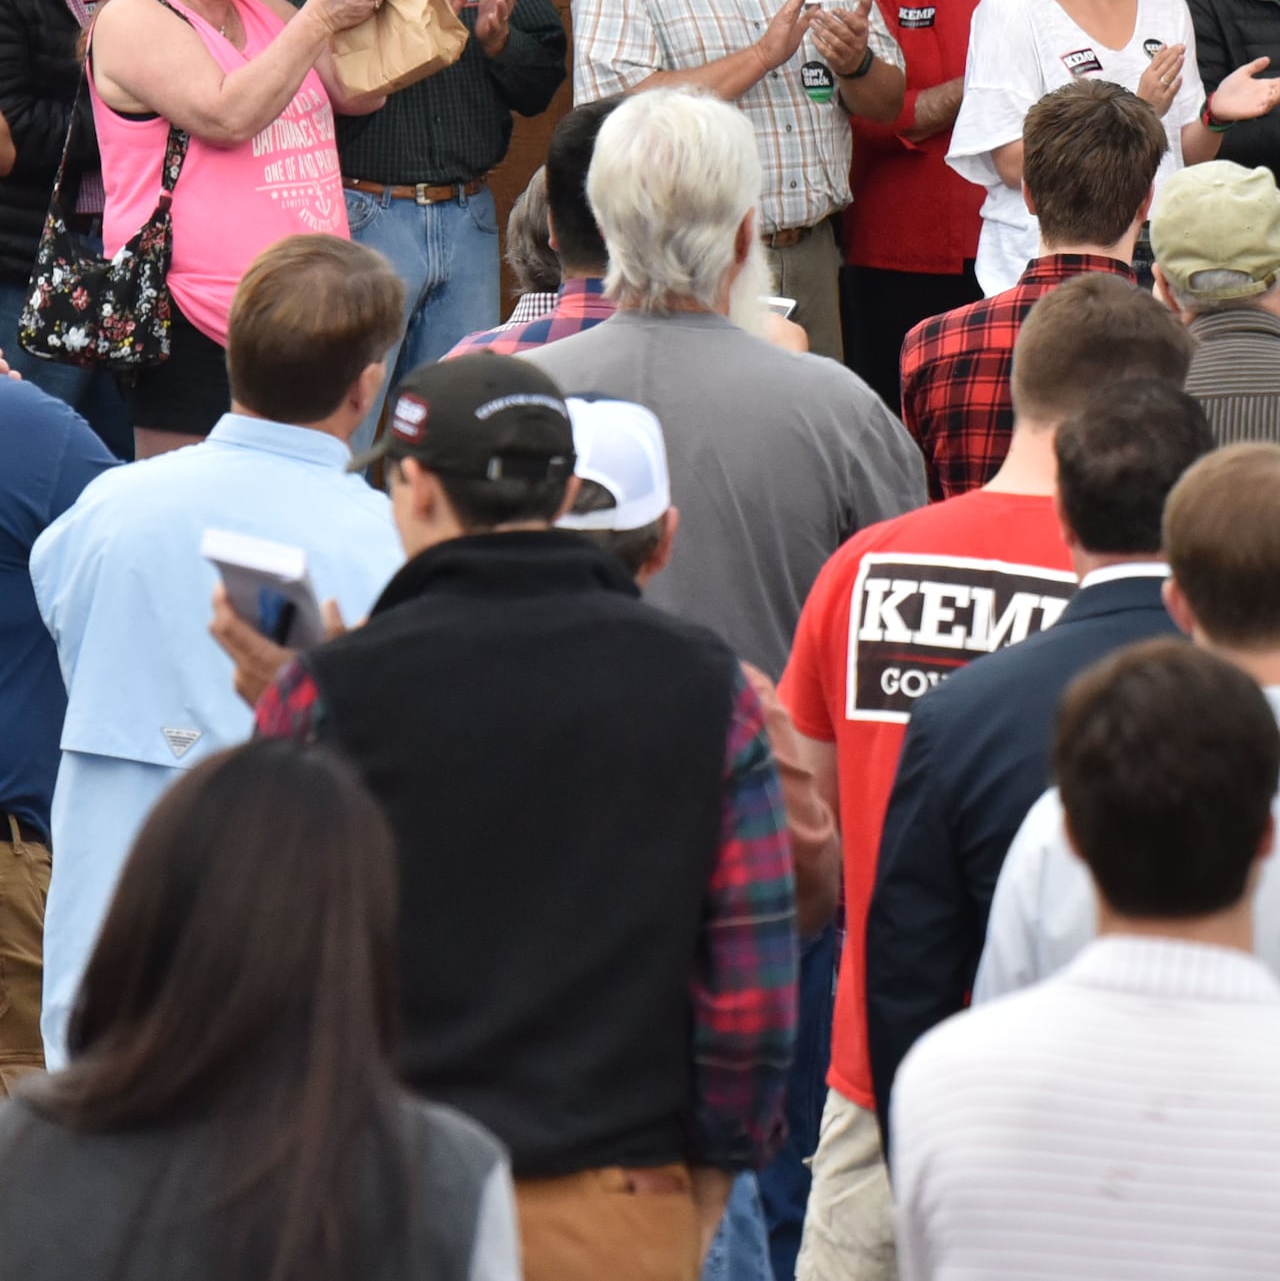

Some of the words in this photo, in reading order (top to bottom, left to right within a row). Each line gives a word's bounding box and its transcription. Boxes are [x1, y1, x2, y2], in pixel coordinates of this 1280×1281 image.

[898, 7, 936, 20] KEMP
[1063, 51, 1097, 68] KEMP
[802, 68, 824, 79] Gary
